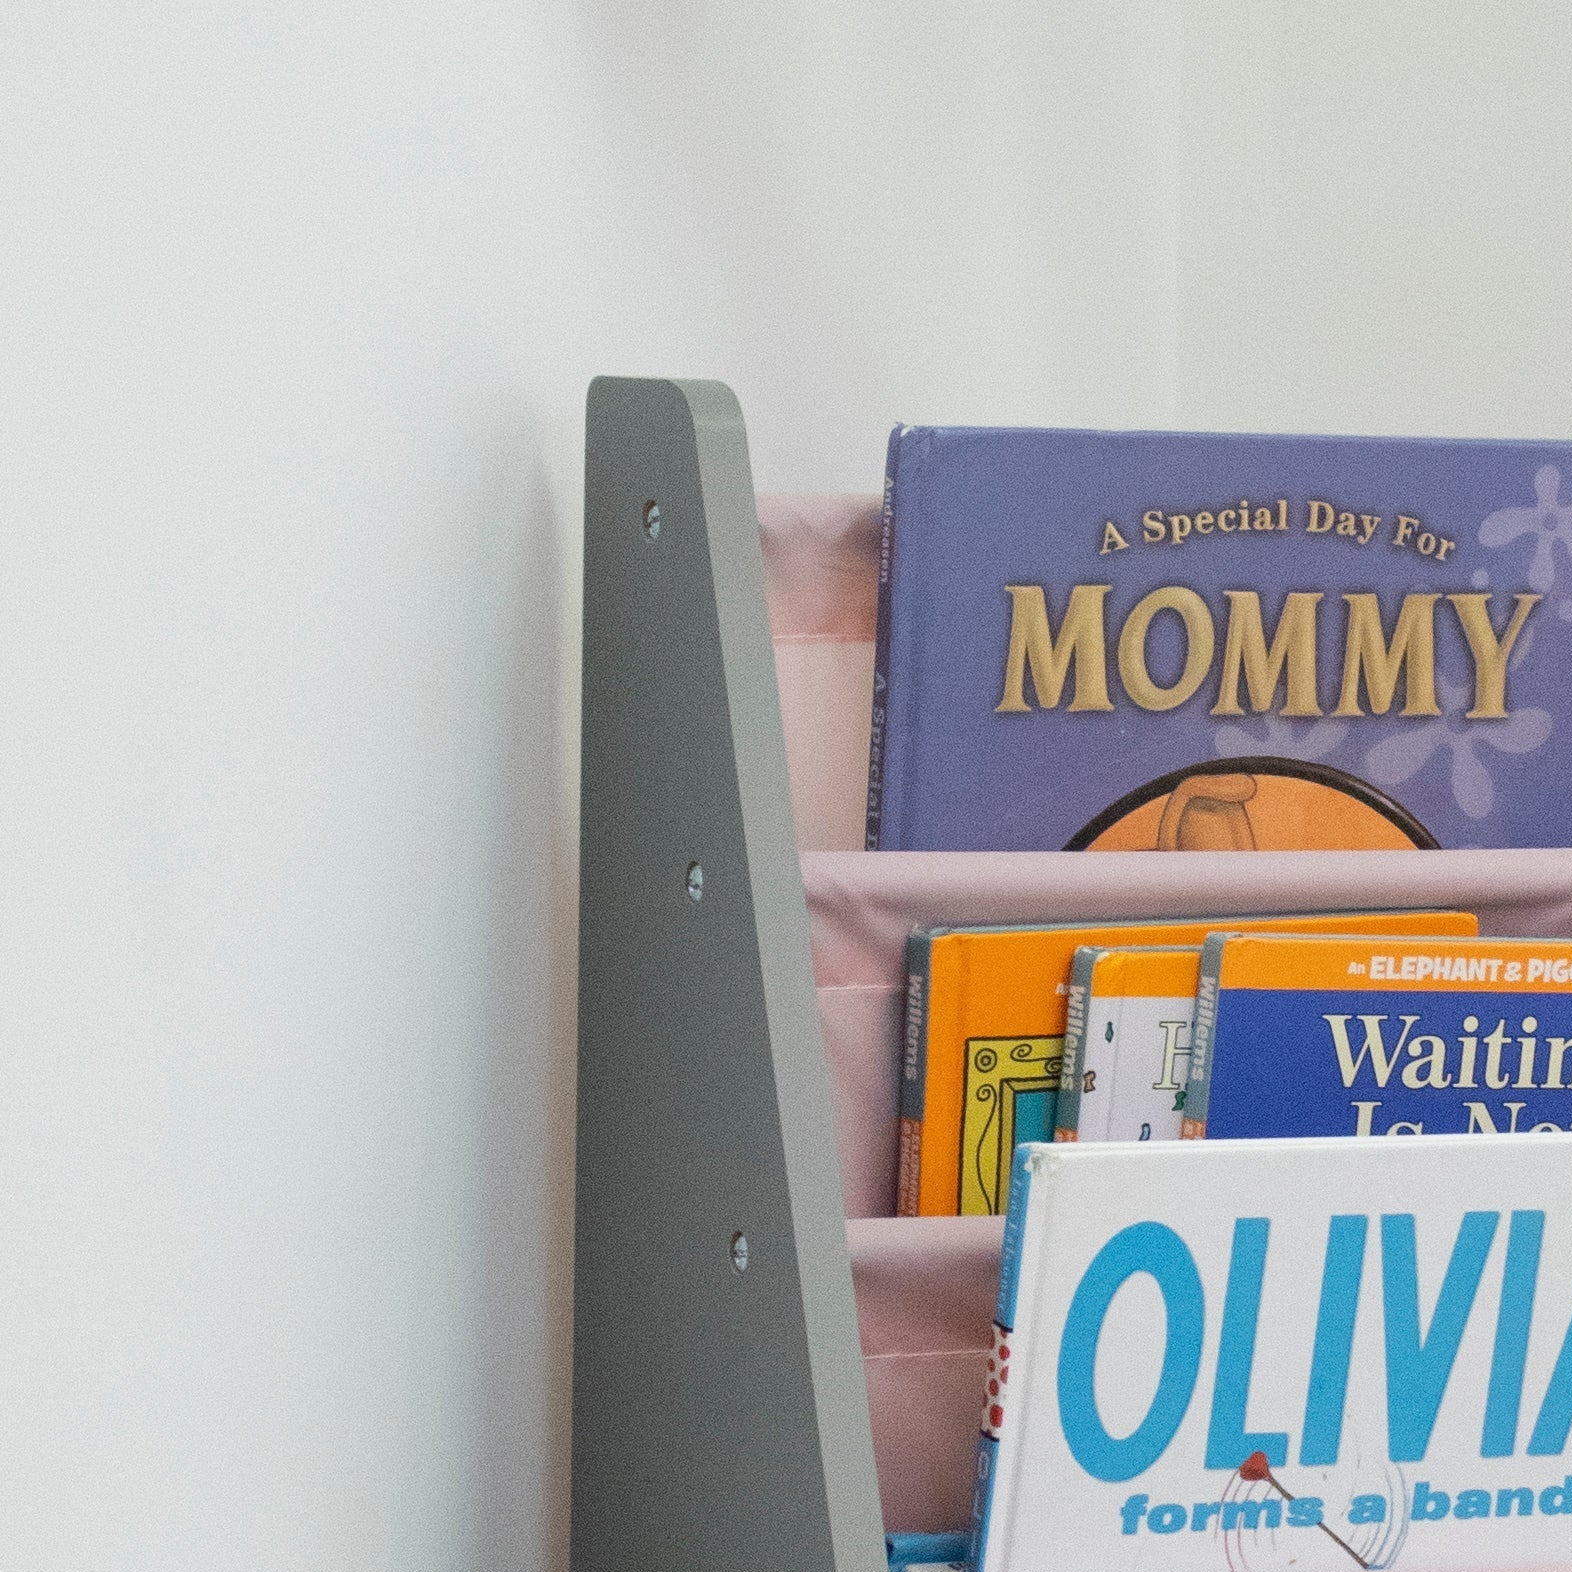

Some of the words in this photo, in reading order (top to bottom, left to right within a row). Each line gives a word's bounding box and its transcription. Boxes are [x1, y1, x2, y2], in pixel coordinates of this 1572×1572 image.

[1099, 522, 1129, 555] A
[1142, 499, 1289, 543] Special
[1306, 501, 1381, 545] Day
[1392, 516, 1457, 561] For
[995, 585, 1543, 719] MOMMY
[1347, 961, 1366, 976] An
[1369, 955, 1503, 983] ELEPHANT
[1504, 961, 1521, 983] &
[905, 974, 923, 1081] Willems
[1061, 985, 1086, 1090] Willems
[1192, 976, 1216, 1081] Willems
[1120, 1492, 1326, 1536] forms
[1348, 1496, 1388, 1526] a
